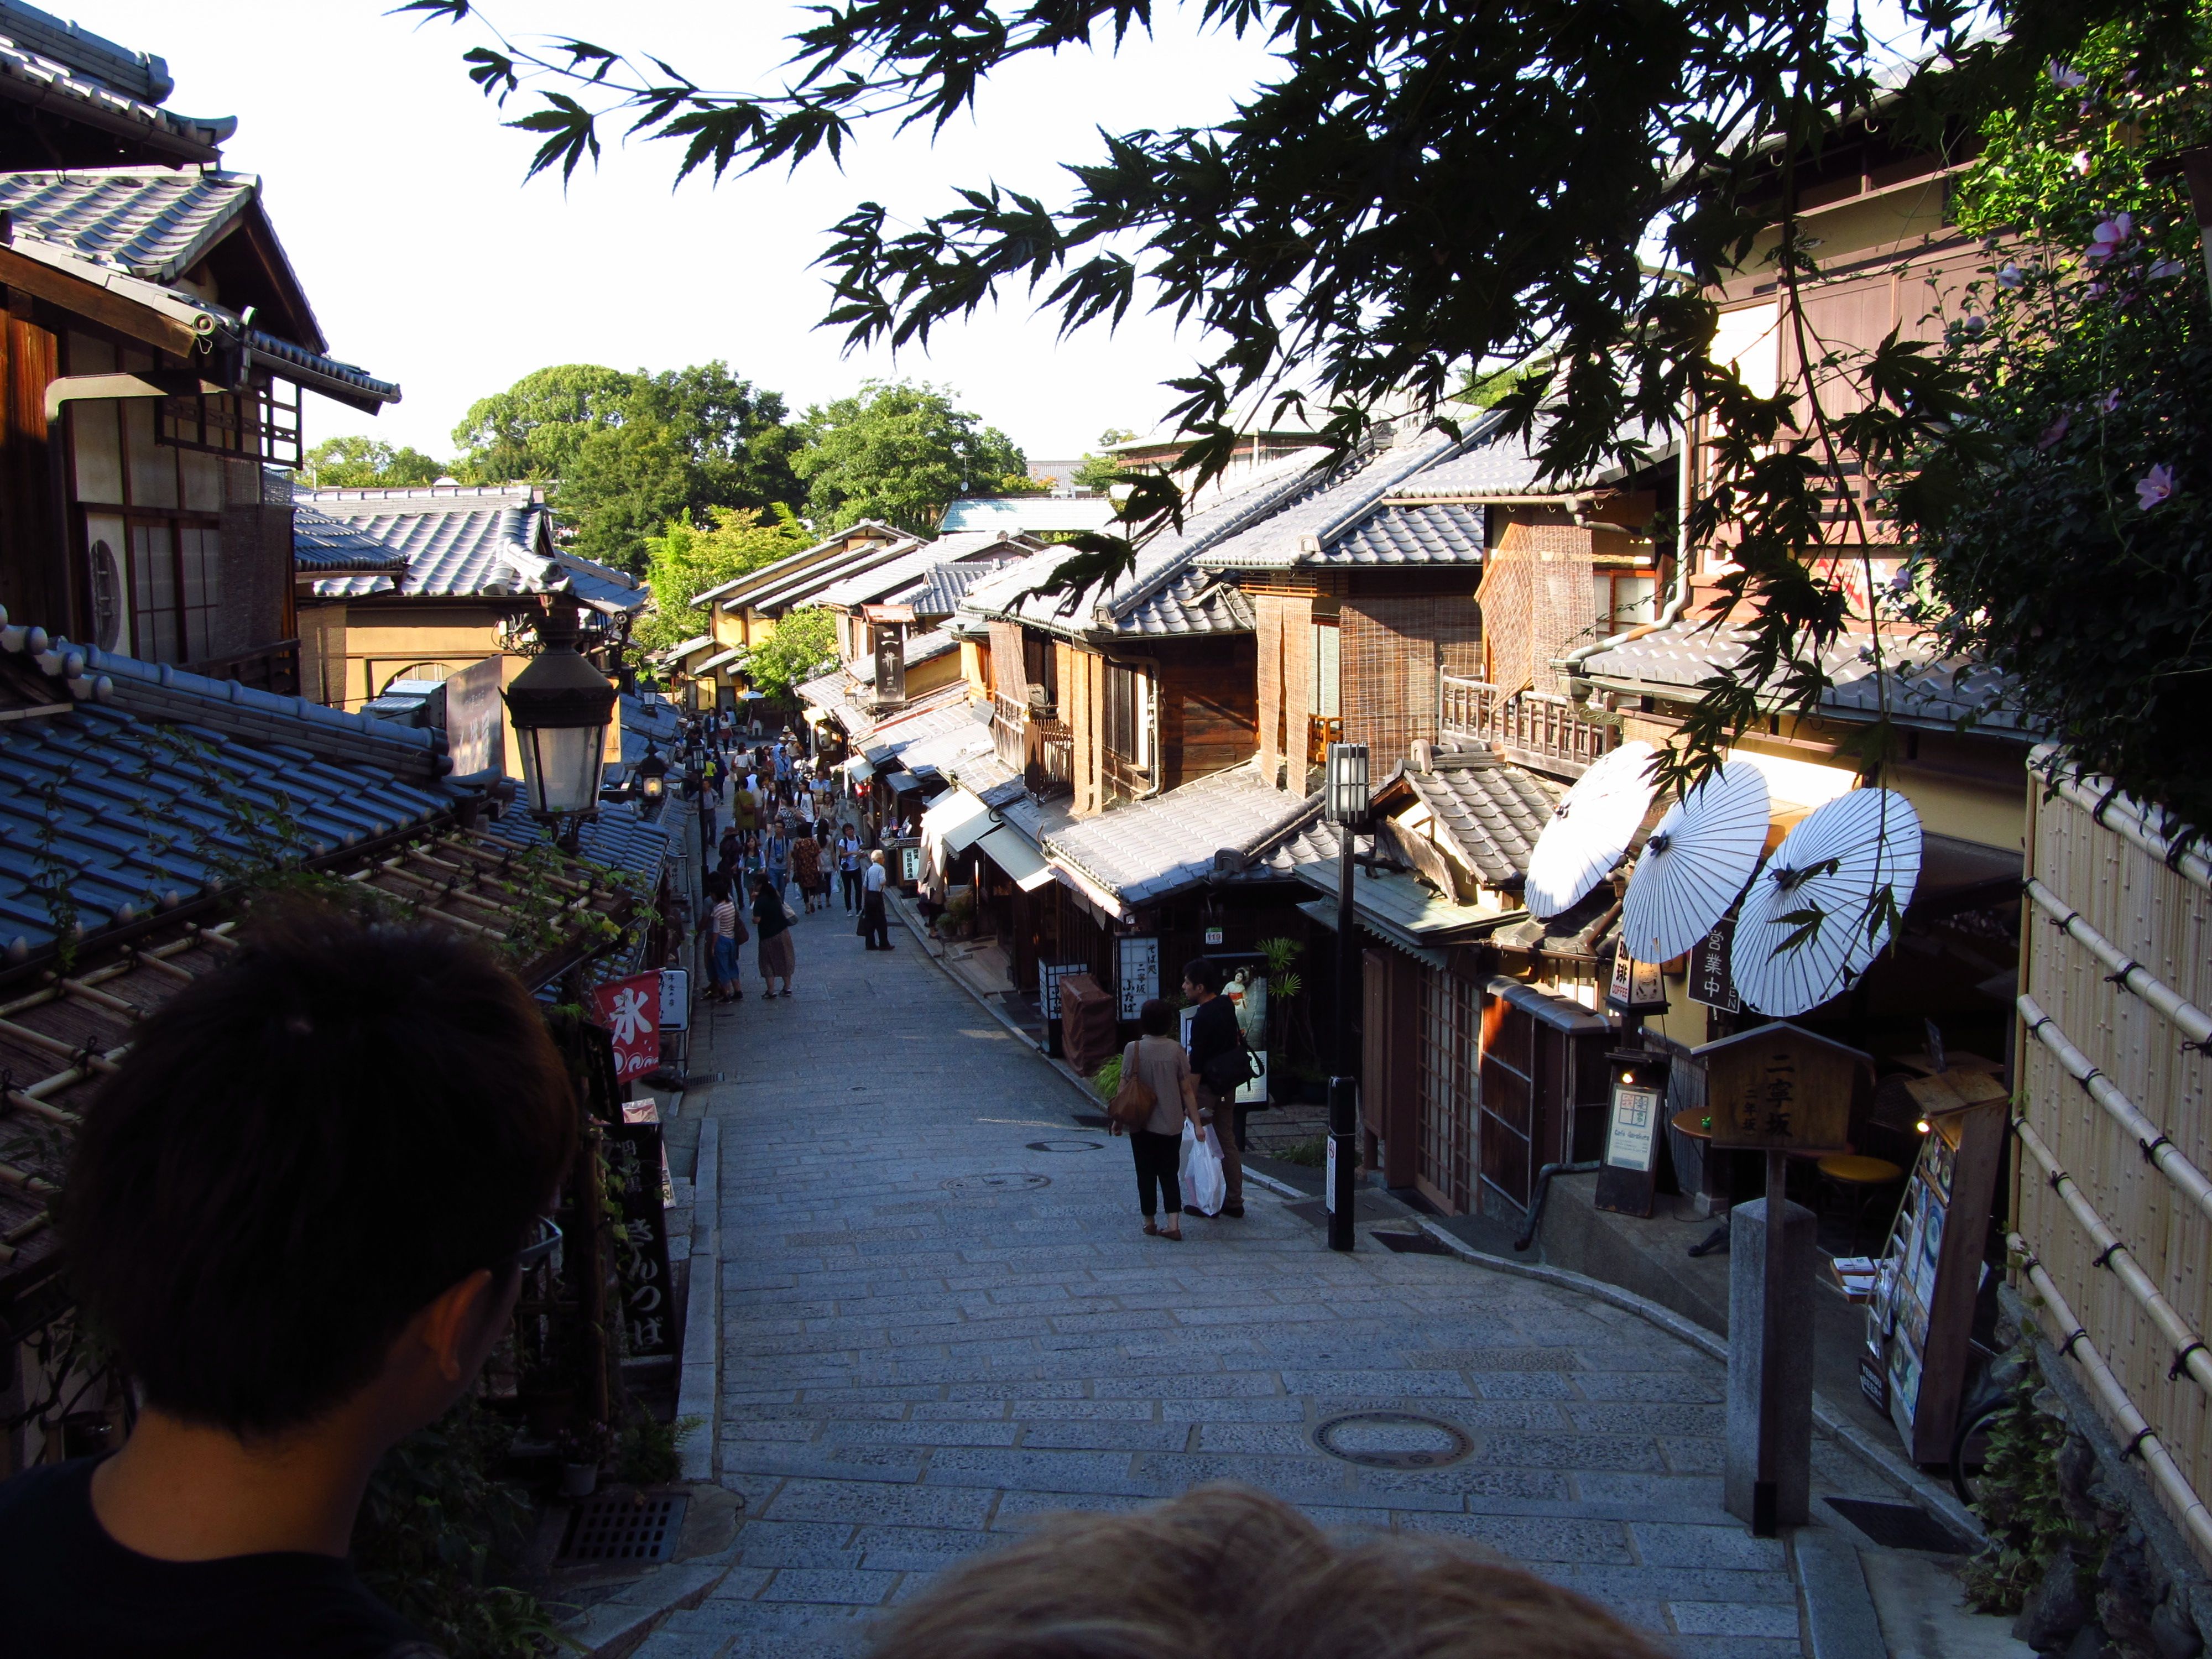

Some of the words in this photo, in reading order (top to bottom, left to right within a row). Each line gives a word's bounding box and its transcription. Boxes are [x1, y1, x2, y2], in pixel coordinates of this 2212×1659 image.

[1147, 944, 1157, 974] そば処
[1704, 929, 1724, 998] 営業中
[609, 987, 653, 1045] 氷
[1123, 979, 1136, 1012] ふたば
[1611, 984, 1628, 998] COFFEE
[1766, 1055, 1795, 1138] 二寧坂
[628, 1218, 664, 1347] きんつば
